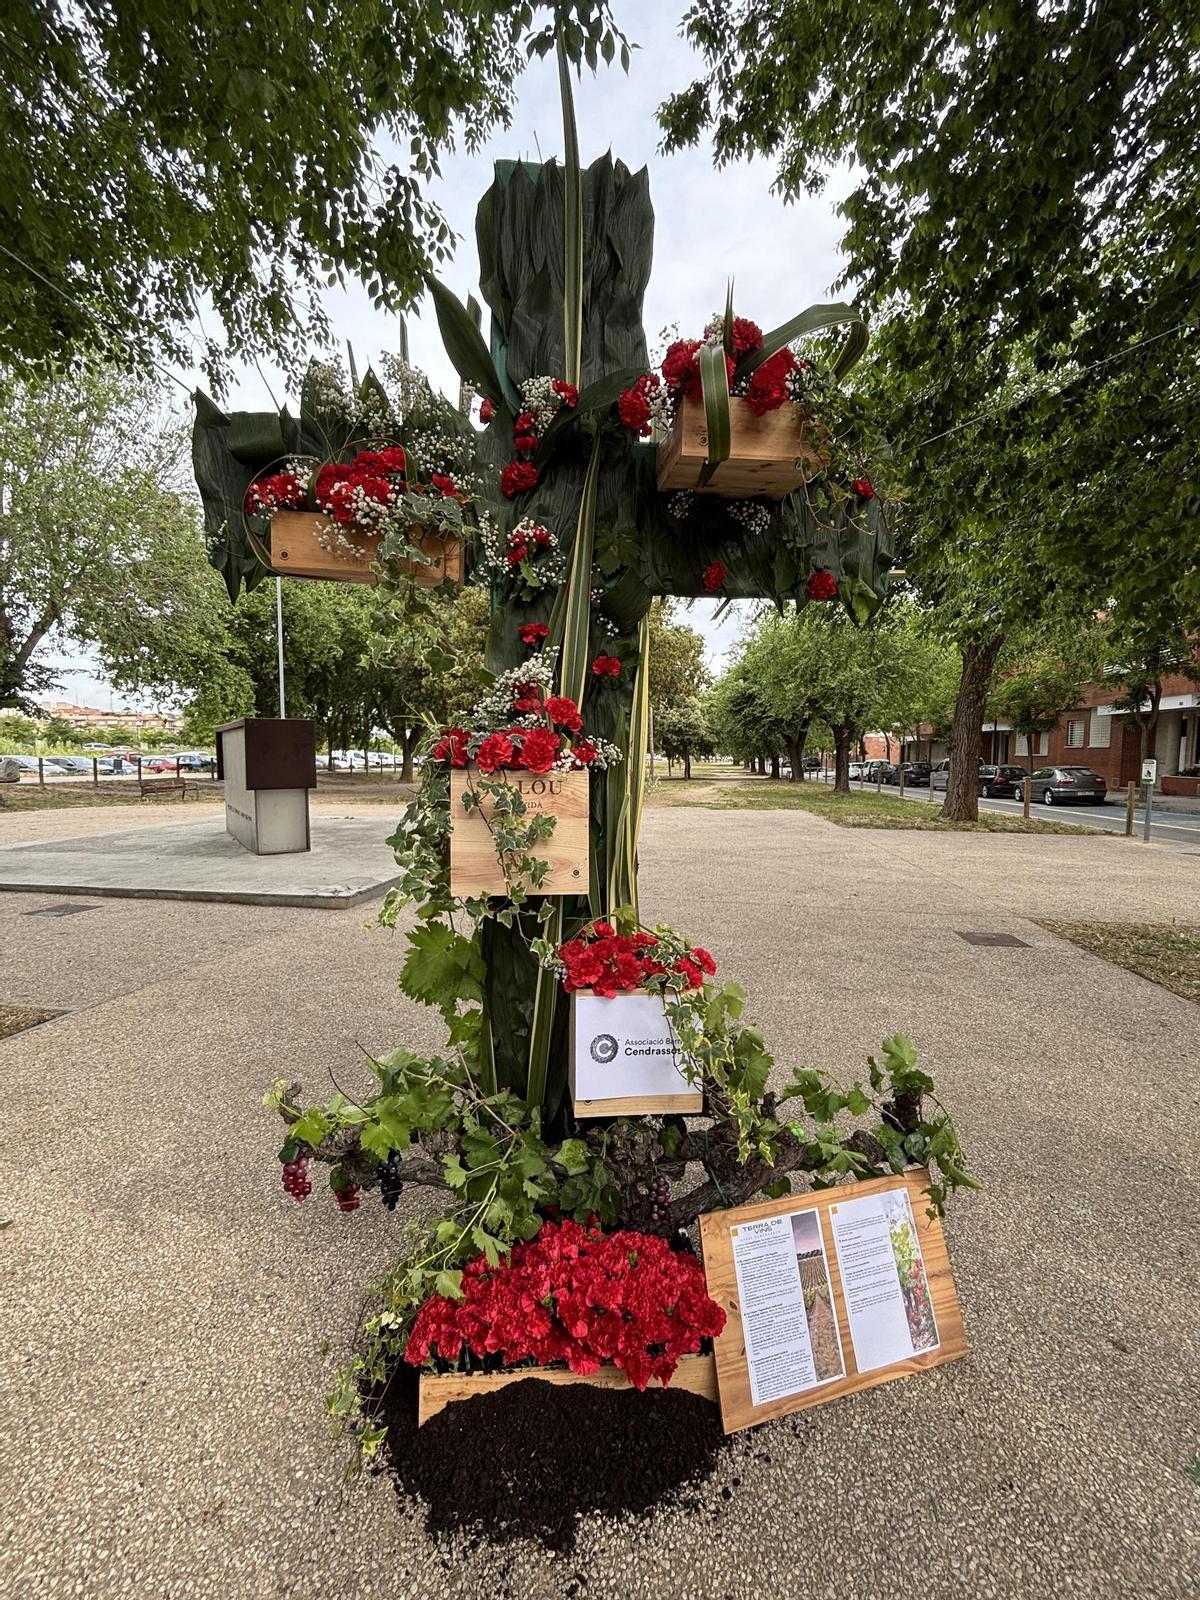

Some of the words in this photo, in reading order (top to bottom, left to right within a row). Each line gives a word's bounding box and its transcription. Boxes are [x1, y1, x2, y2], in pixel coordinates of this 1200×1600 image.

[624, 1038, 664, 1046] Associació
[742, 1222, 769, 1232] TERRA
[753, 1226, 772, 1234] VINS
